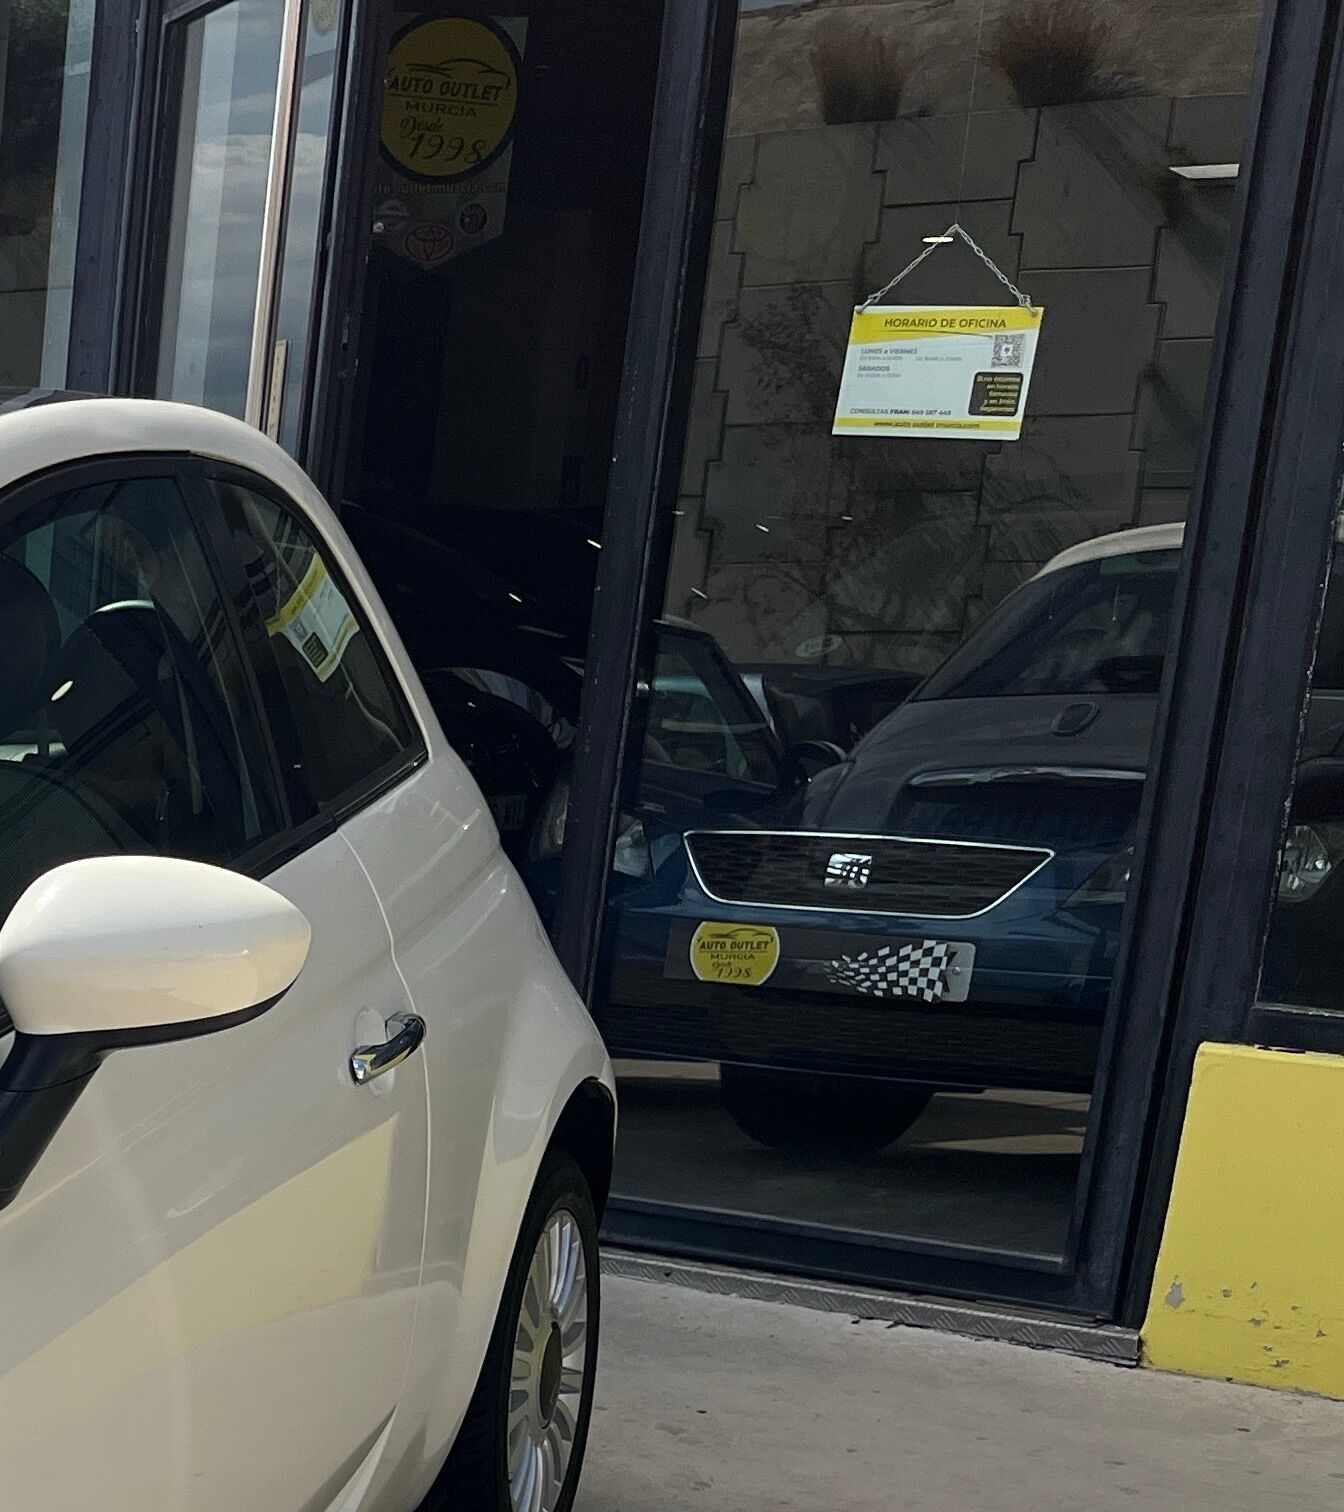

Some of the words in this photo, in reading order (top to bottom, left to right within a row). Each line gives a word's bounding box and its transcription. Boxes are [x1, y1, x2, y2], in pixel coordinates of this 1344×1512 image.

[387, 77, 433, 94] AUTO
[439, 80, 504, 101] OUTLET
[405, 101, 476, 117] MURCIA
[409, 133, 487, 163] 1998
[884, 318, 938, 328] HORARIO
[940, 318, 956, 328] DE
[959, 318, 1007, 329] OFICINA
[699, 940, 727, 950] AUTO
[729, 940, 769, 951] OUTLET
